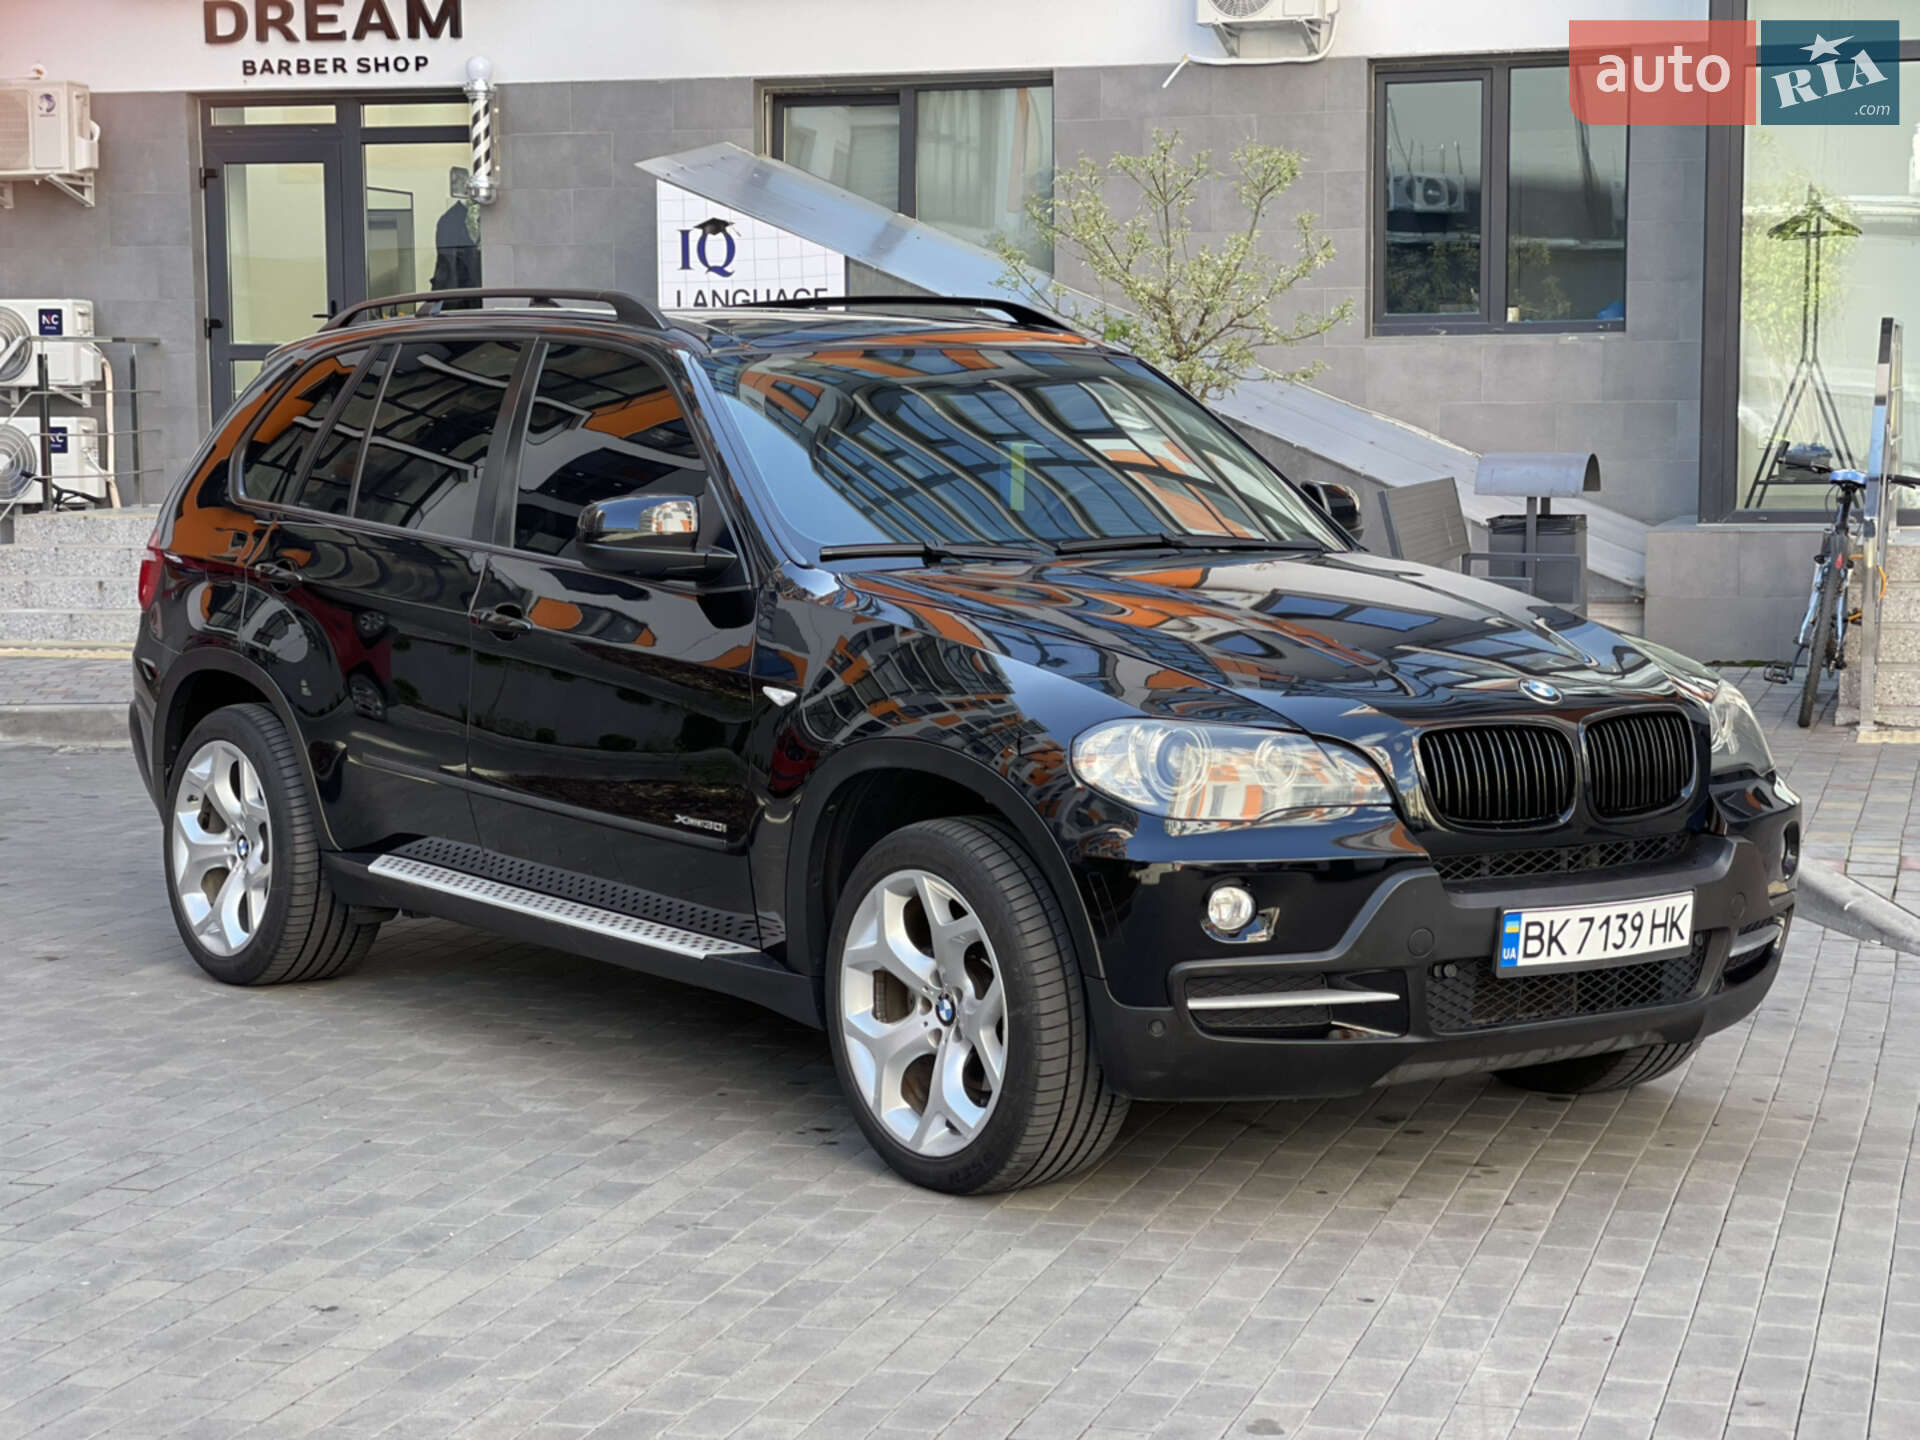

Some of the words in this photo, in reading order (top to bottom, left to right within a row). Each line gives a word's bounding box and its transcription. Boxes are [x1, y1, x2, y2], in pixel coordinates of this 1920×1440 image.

[203, 0, 463, 44] DREAM
[242, 57, 348, 76] BARBER
[356, 55, 429, 74] SHOP
[677, 224, 737, 277] IQ
[1522, 918, 1571, 959] BK
[1576, 911, 1644, 955] 7139
[1650, 904, 1689, 945] HK
[1503, 948, 1517, 960] UA
